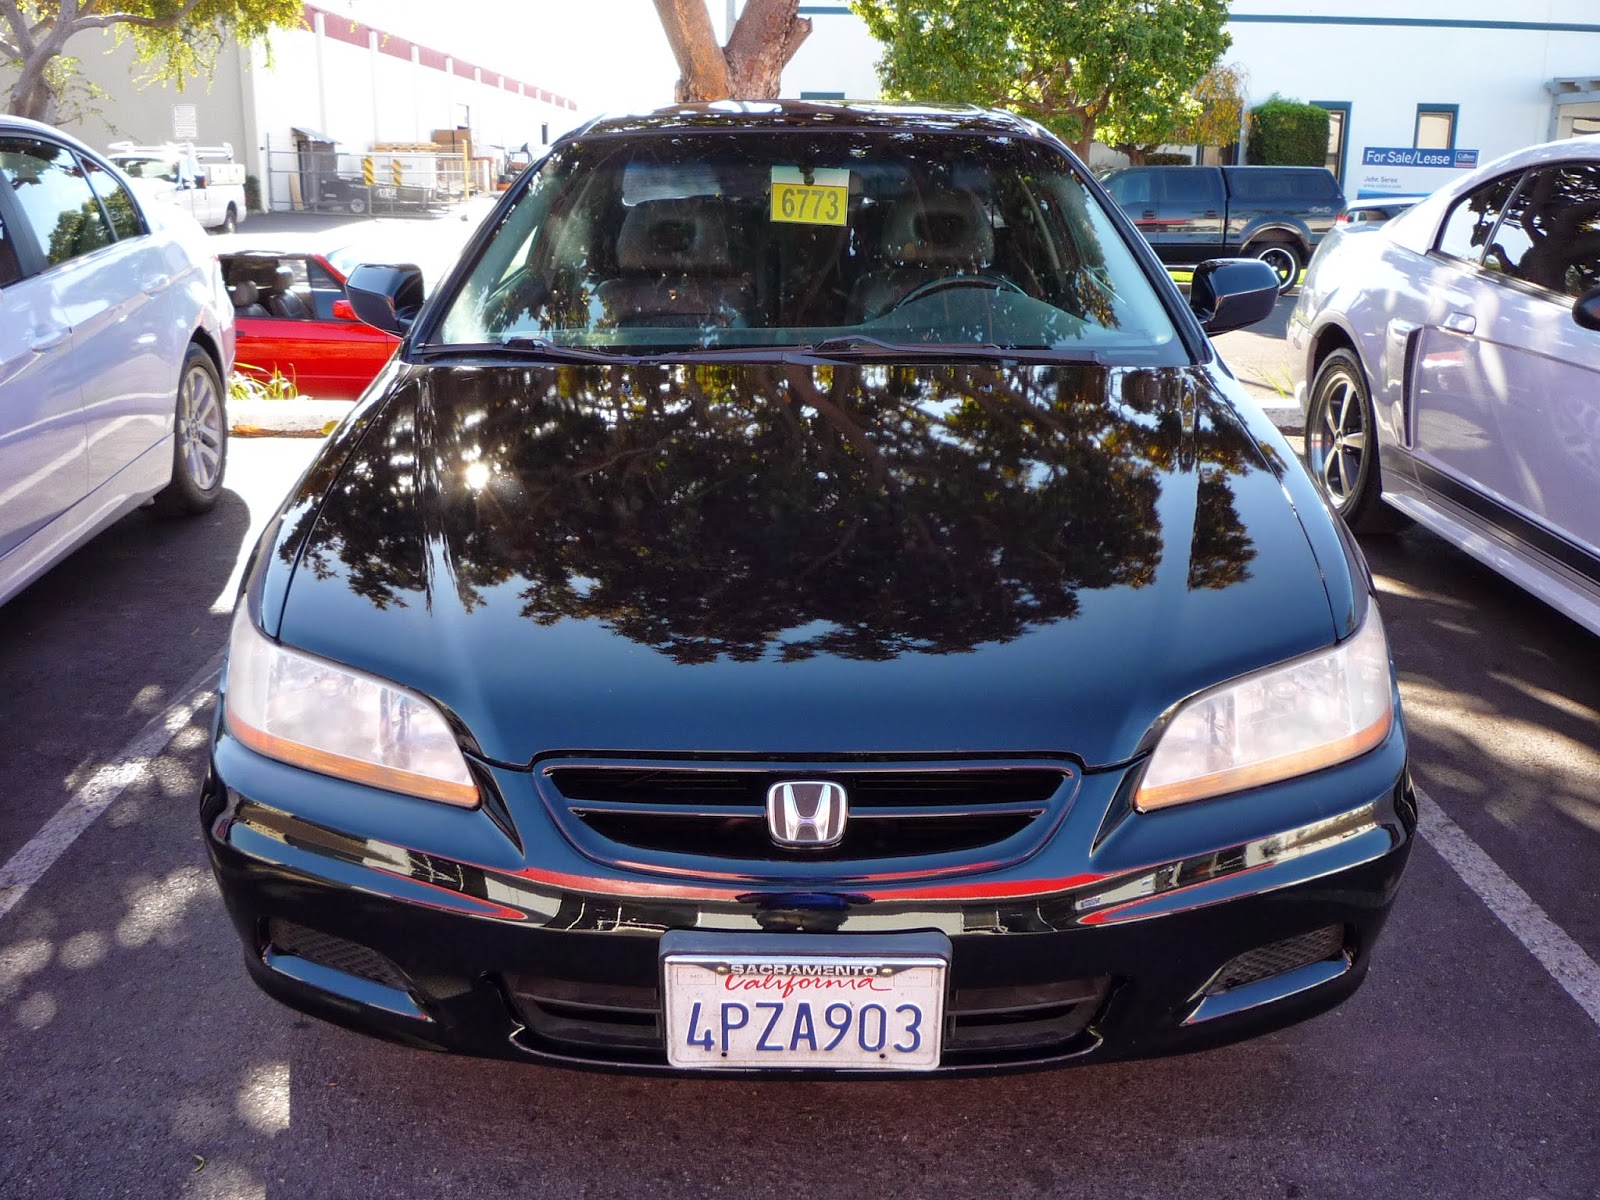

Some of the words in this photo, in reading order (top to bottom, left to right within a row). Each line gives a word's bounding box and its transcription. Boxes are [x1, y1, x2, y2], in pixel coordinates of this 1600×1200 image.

[1366, 150, 1386, 163] For
[1387, 151, 1451, 165] Sale/Lease
[781, 188, 839, 221] 6773
[730, 964, 878, 976] SACRAMENTO
[724, 974, 893, 998] California
[686, 1002, 923, 1053] 4PZA903
